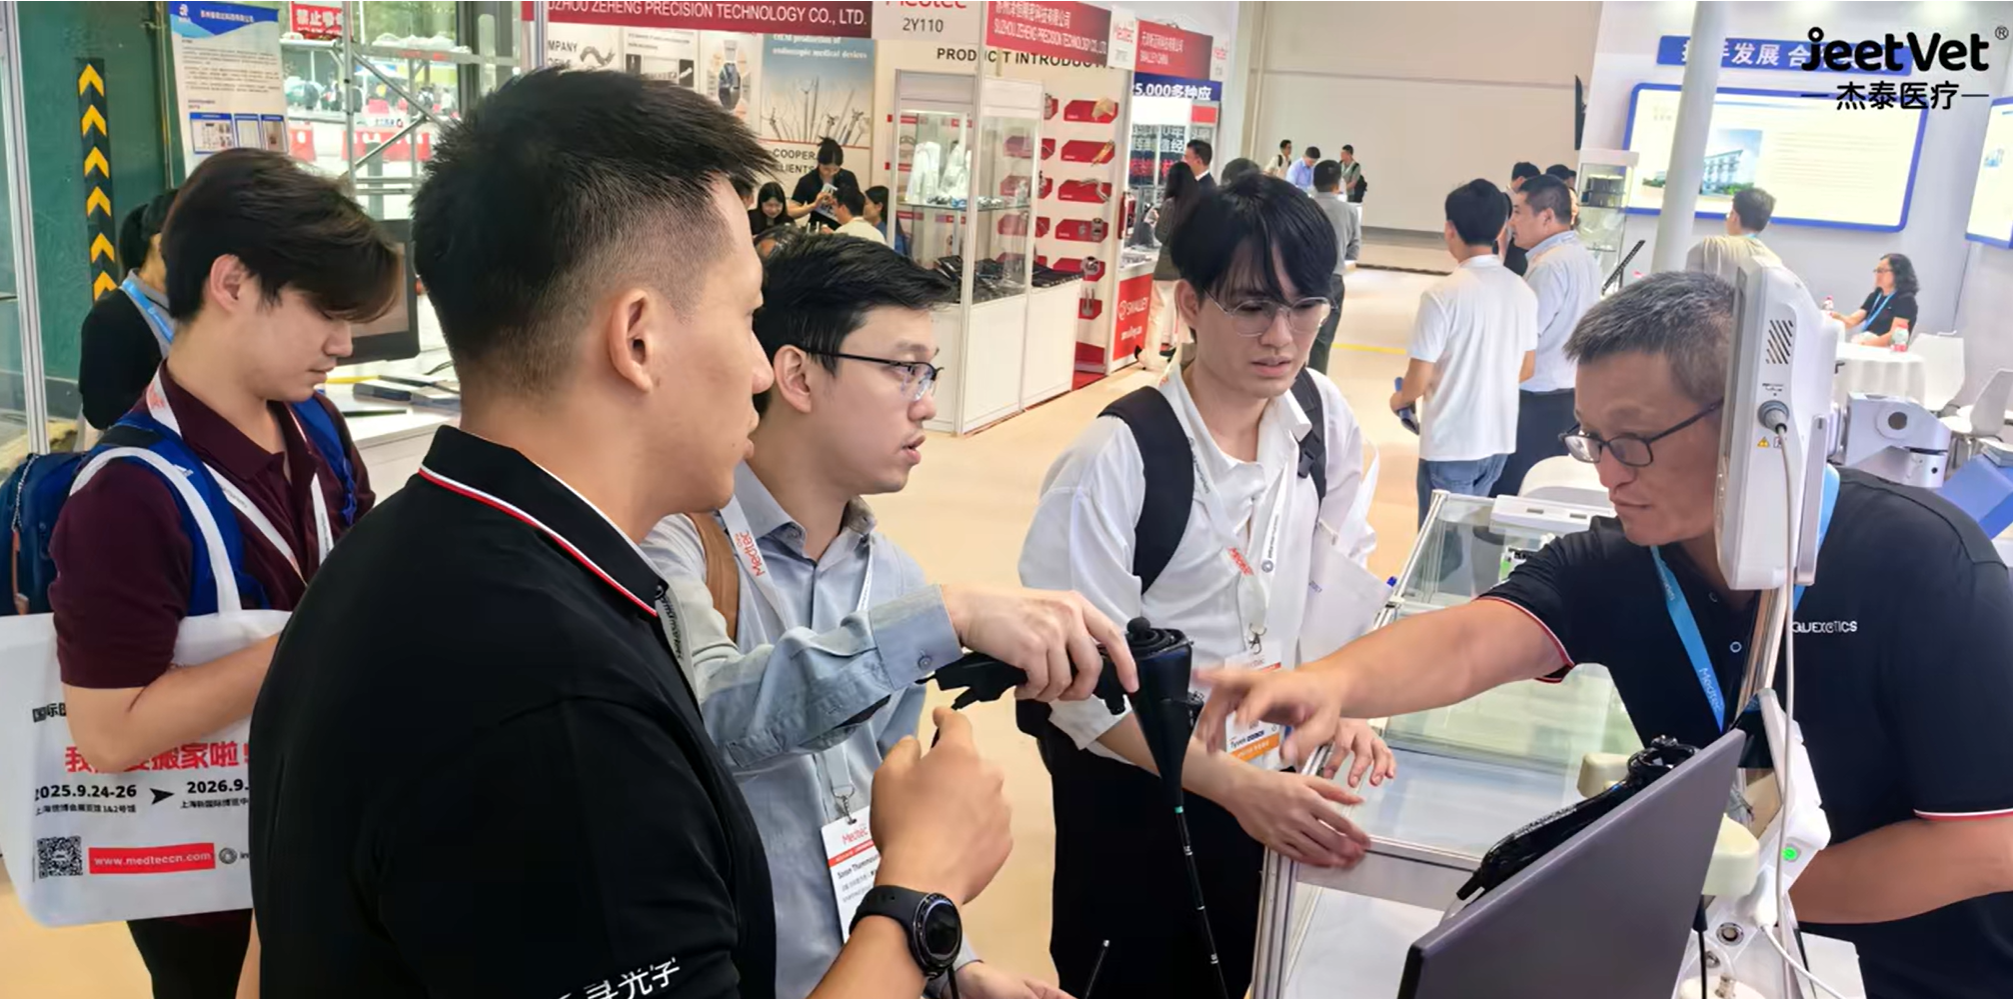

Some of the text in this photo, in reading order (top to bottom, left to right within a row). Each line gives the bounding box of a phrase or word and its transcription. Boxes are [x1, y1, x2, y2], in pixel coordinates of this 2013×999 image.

[548, 0, 588, 12] UZHOU
[592, 1, 641, 14] ZEHENG
[645, 2, 713, 17] PRECISION
[716, 4, 805, 22] TECHNOLOGY
[839, 9, 867, 25] LTD.
[902, 18, 944, 32] 2Y110
[548, 40, 577, 52] MPANY
[937, 47, 1011, 64] PRODCT
[1015, 52, 1115, 69] INTRODU
[772, 148, 817, 160] COOPER
[94, 852, 212, 866] www.medteccn.com
